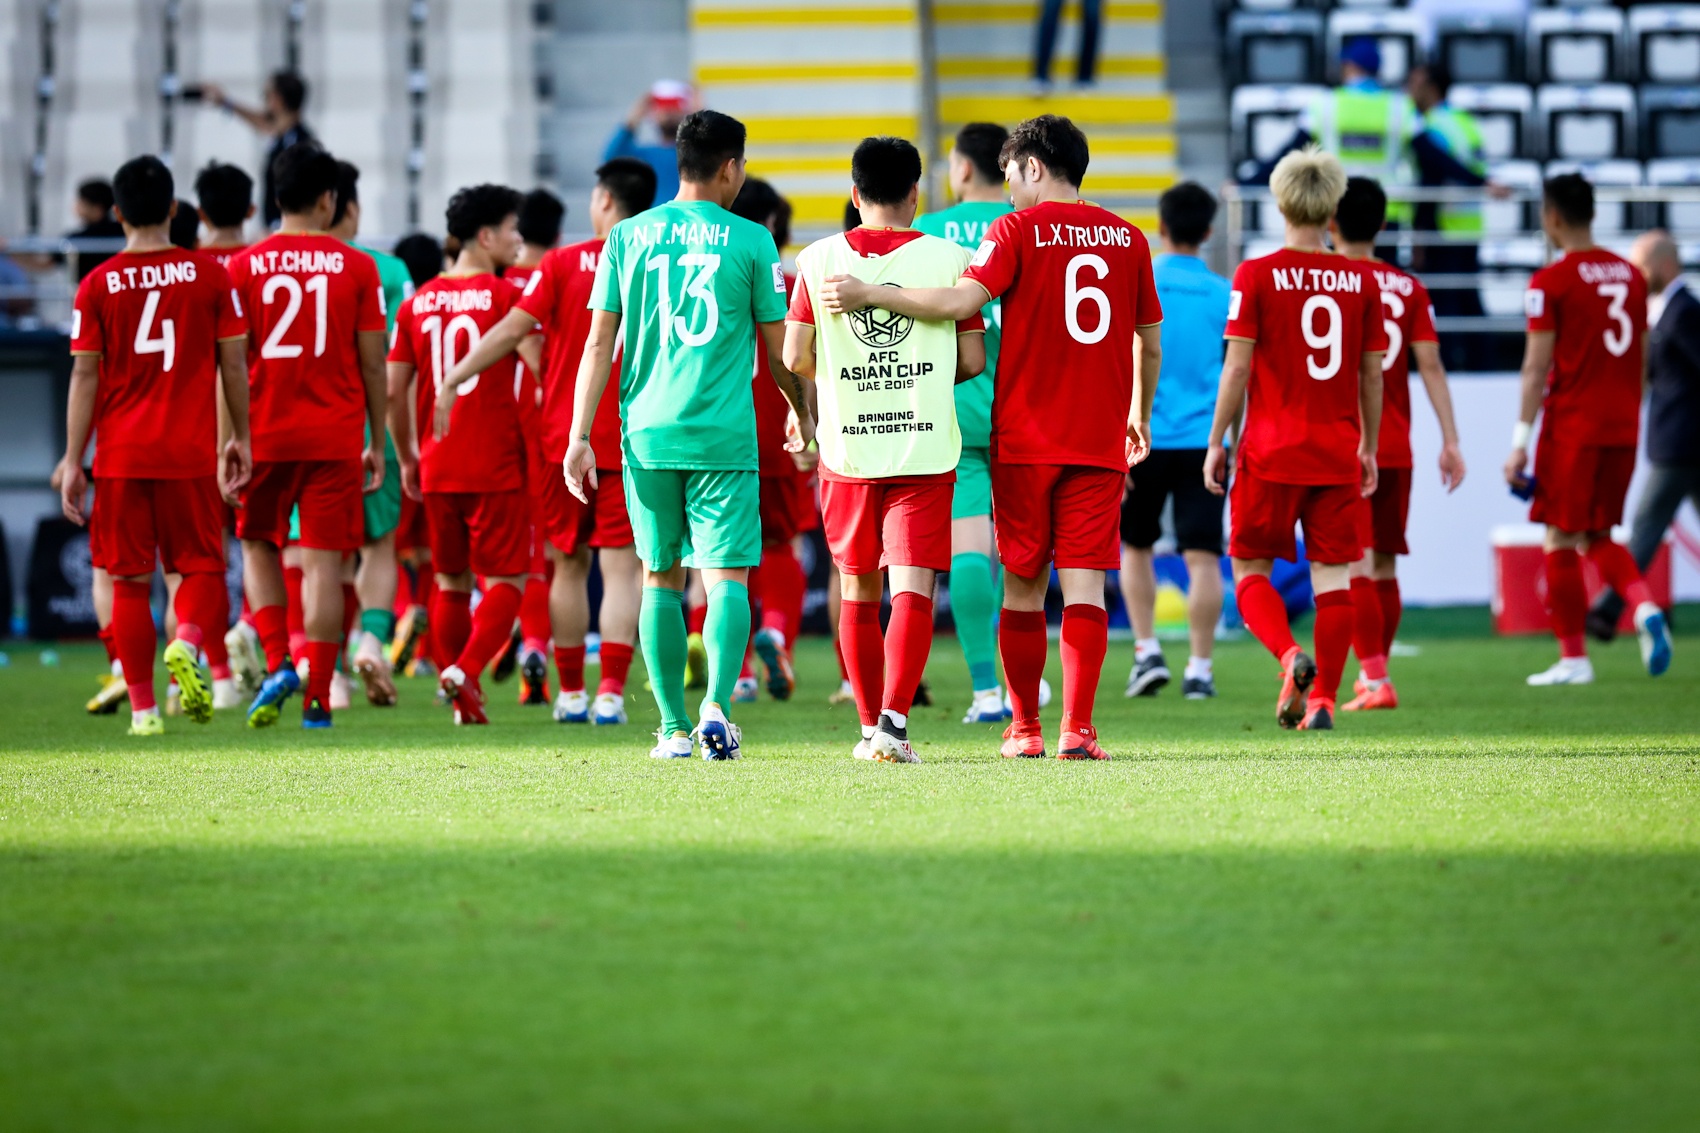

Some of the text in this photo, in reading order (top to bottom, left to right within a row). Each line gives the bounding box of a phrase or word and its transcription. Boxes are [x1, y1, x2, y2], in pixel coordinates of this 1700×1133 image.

[633, 222, 730, 247] N.T.MANH
[1034, 224, 1131, 248] L.X.TRUONG
[250, 250, 344, 276] N.T.CHUNG
[106, 261, 196, 294] B.T.DUNG
[1272, 267, 1361, 293] N.V.TOAN
[647, 253, 721, 347] 13
[1064, 253, 1111, 344] 6
[261, 274, 328, 359] 21
[1597, 282, 1633, 357] 3
[134, 290, 175, 372] 4
[1301, 294, 1342, 381] 9
[421, 314, 480, 396] 10
[868, 351, 899, 363] AFC
[840, 362, 934, 380] ASIAN CUP
[858, 379, 914, 392] UAE 2019
[842, 422, 933, 435] ASIA TOGETHER
[858, 411, 914, 423] BRINGING
